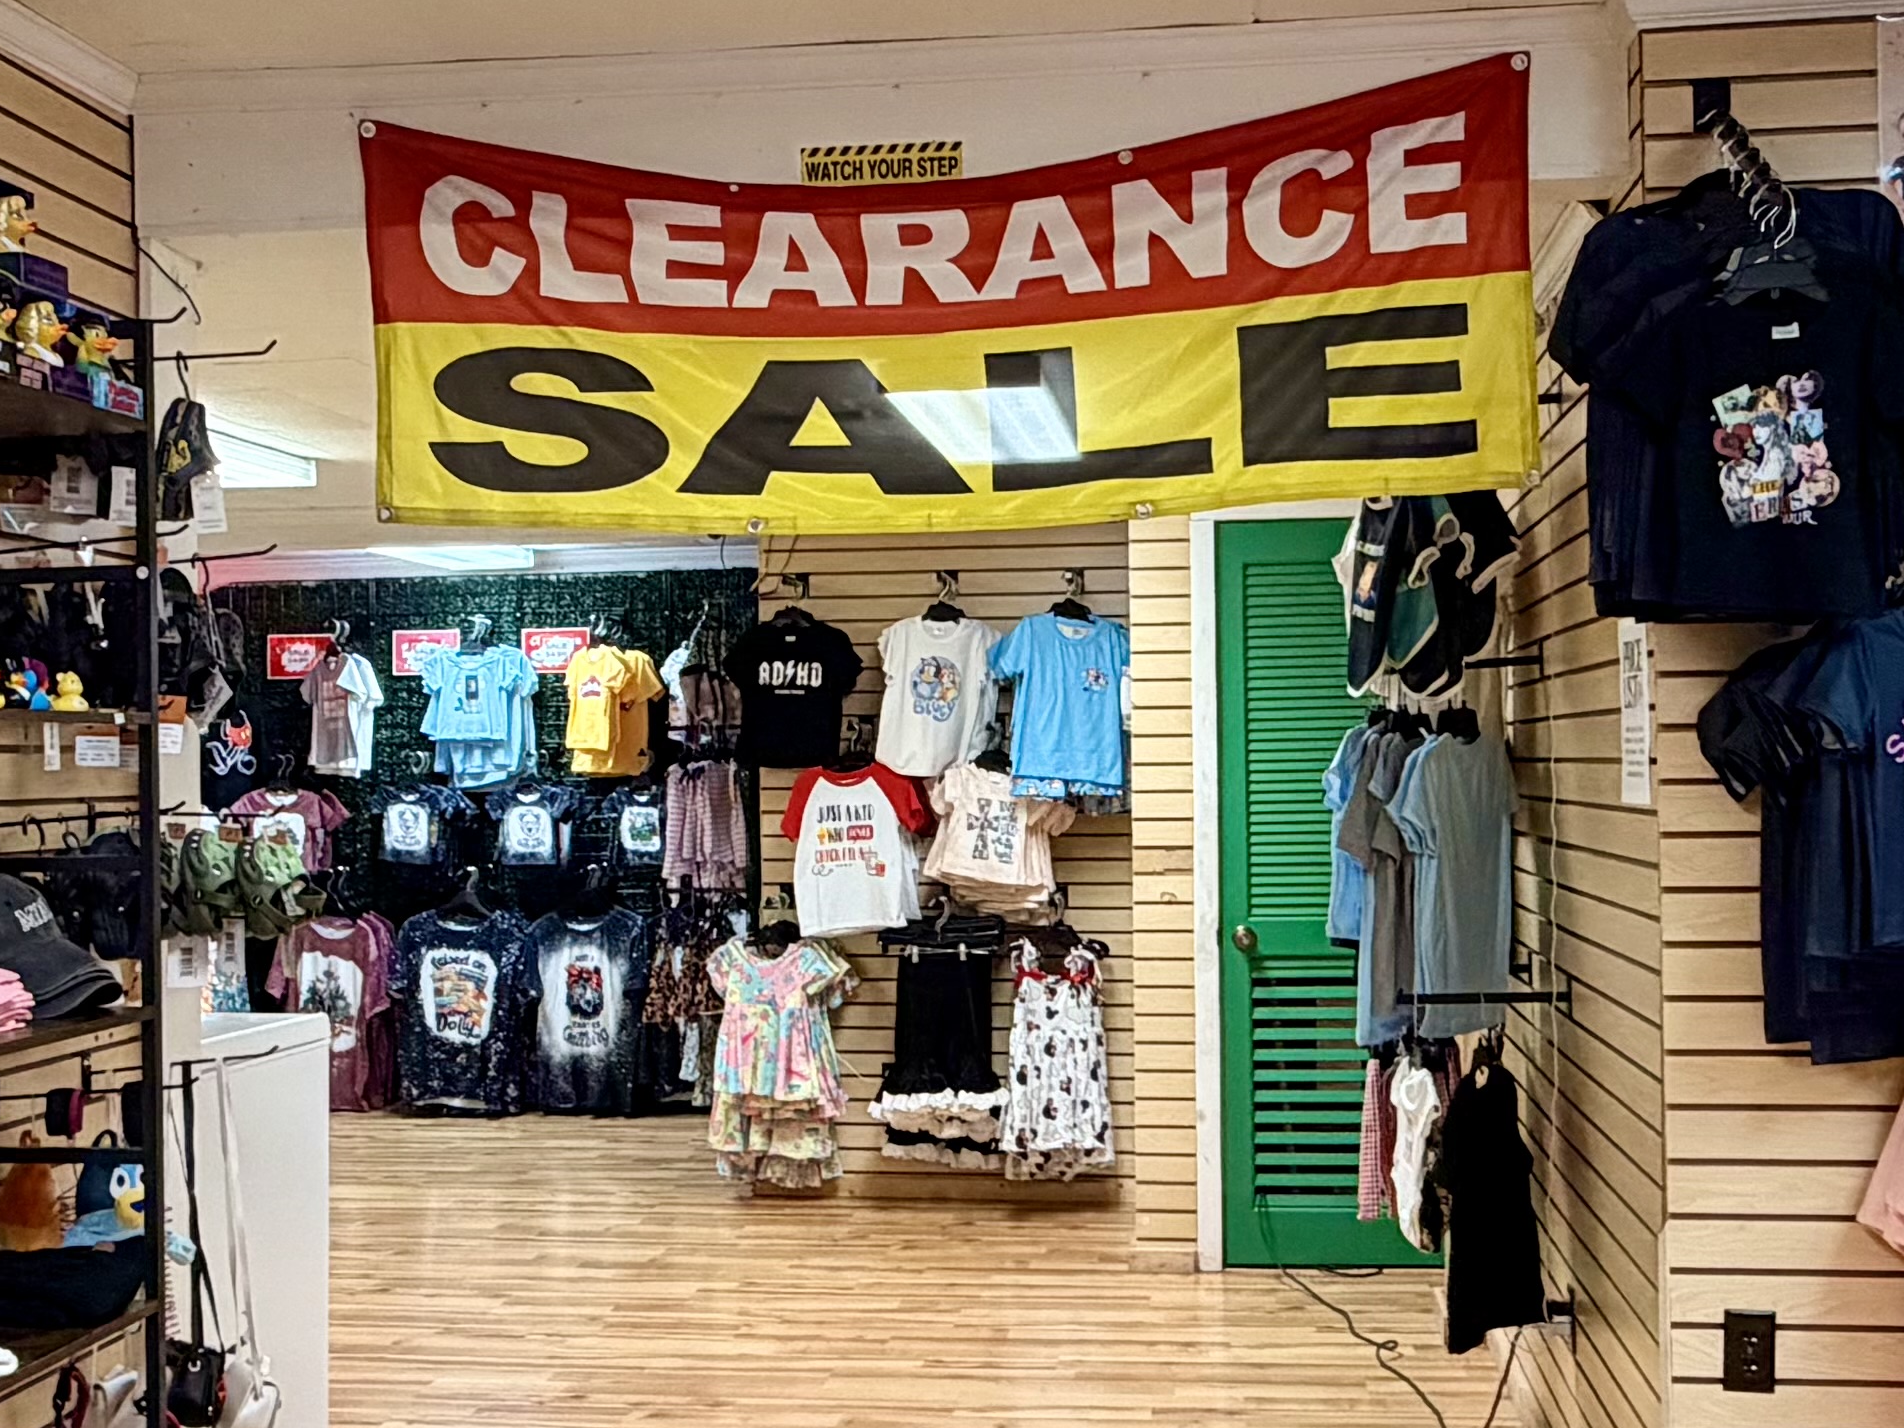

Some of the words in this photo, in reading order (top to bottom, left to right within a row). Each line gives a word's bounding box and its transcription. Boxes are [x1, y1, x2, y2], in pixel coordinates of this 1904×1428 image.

[805, 160, 864, 182] WATCH
[867, 158, 913, 180] YOUR
[917, 156, 959, 178] STEP
[419, 111, 1470, 308] CLEARANCE
[427, 304, 1480, 496] SALE
[817, 805, 842, 823] JUST
[436, 1012, 482, 1040] Dolly
